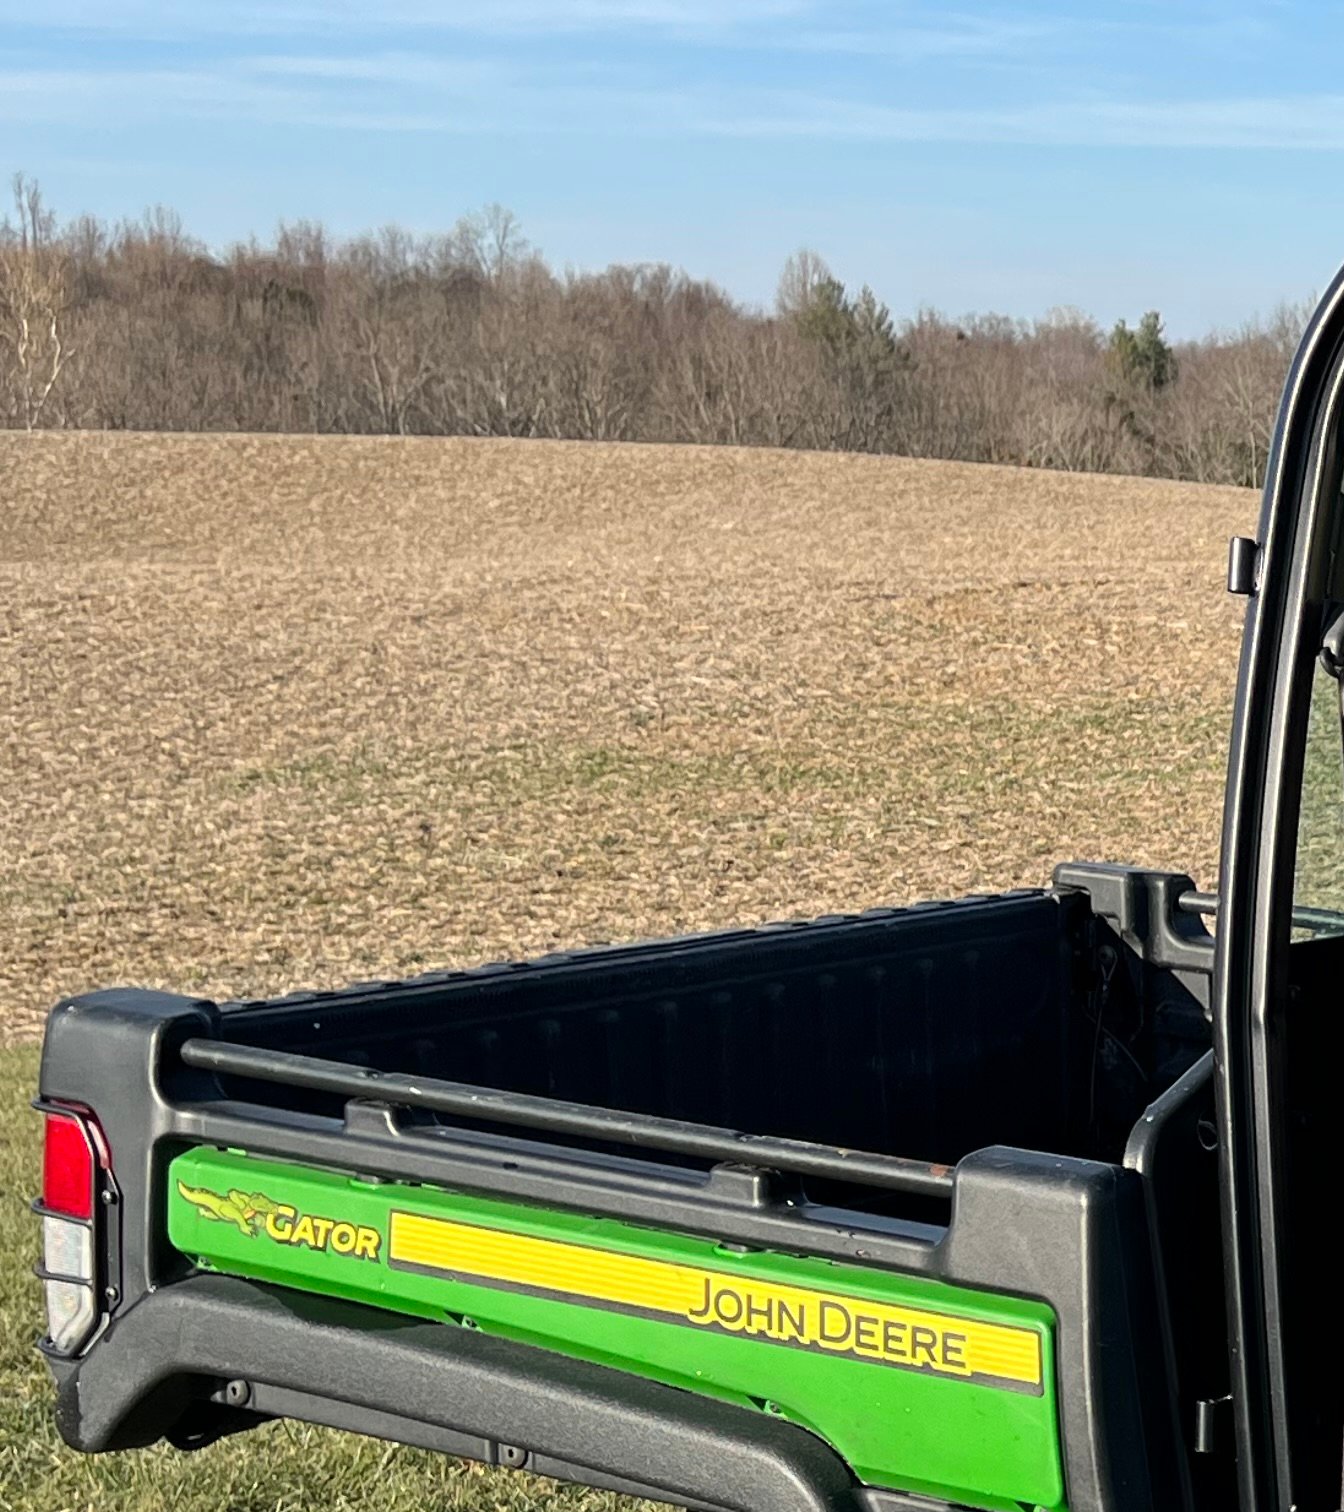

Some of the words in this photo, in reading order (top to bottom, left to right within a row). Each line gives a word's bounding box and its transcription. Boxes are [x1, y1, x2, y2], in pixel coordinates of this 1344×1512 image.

[264, 1204, 381, 1263] GATOR
[688, 1277, 805, 1338] JOHN
[818, 1300, 967, 1369] DEERE
